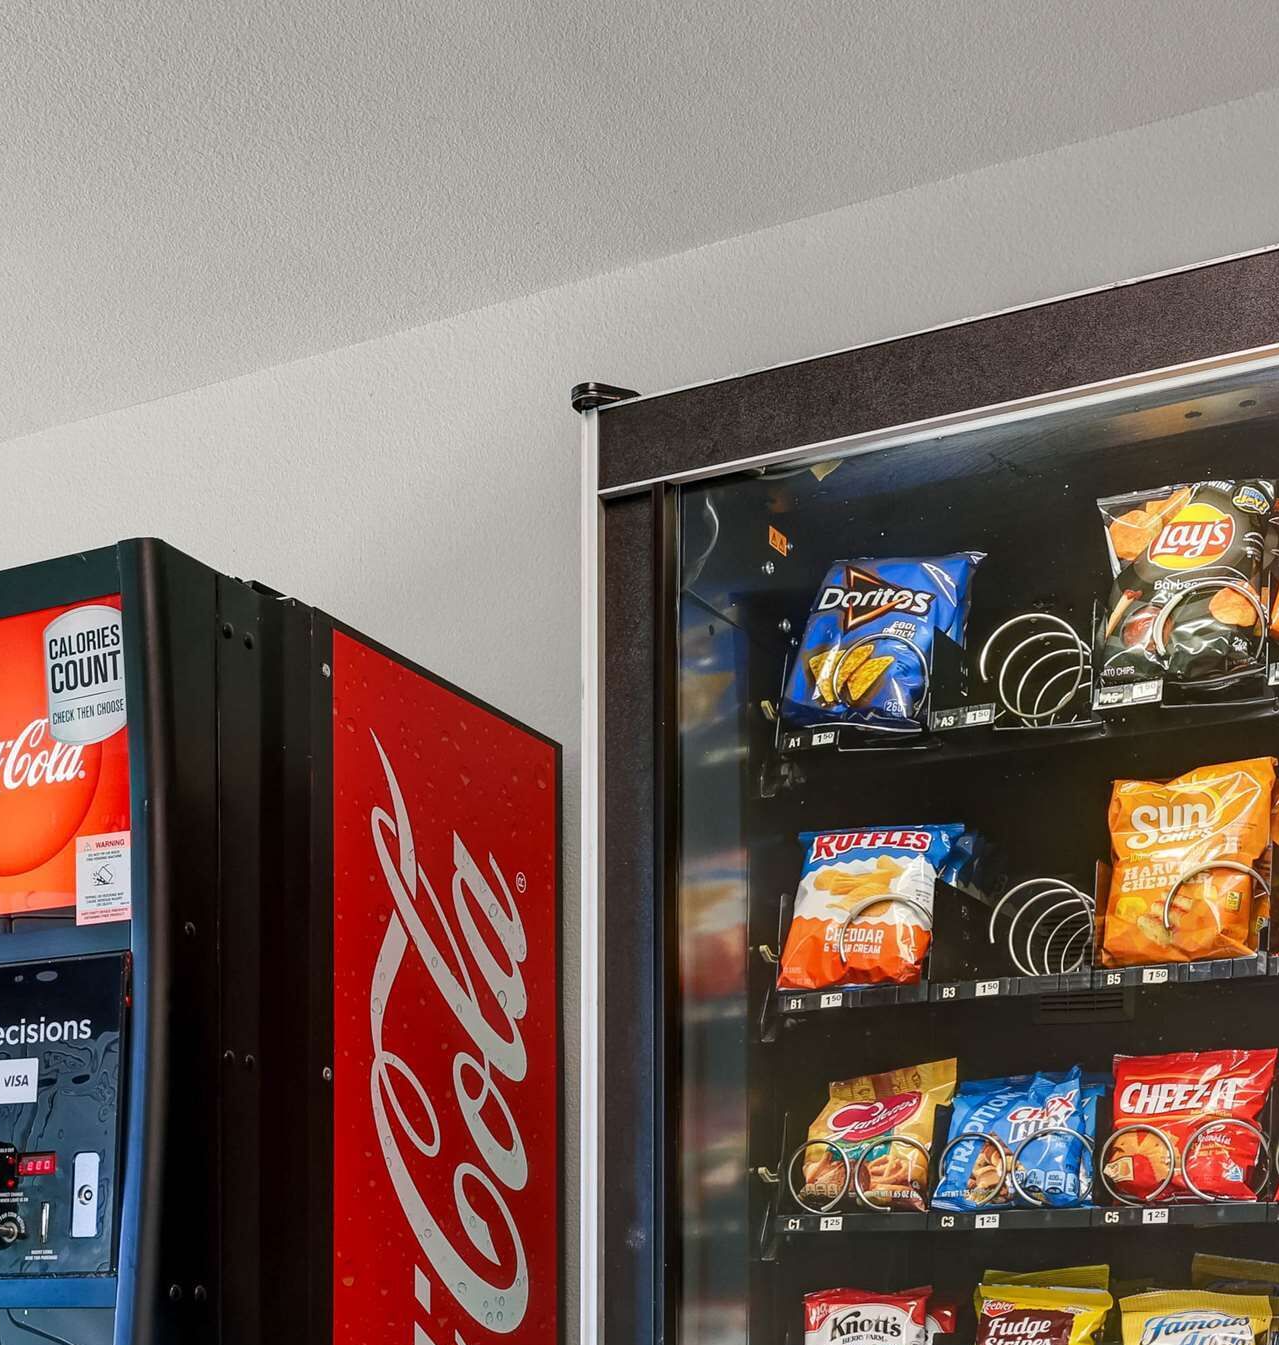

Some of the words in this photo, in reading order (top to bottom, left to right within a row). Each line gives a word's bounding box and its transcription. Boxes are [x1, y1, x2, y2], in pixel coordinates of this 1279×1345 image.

[1156, 520, 1227, 558] Lay's
[819, 587, 933, 614] Doritos
[891, 620, 916, 631] COOL
[49, 624, 120, 660] CALORIES
[51, 650, 121, 694] COUNT
[53, 706, 75, 725] CHECK
[77, 703, 95, 720] THEN
[97, 699, 124, 717] CHOOSE
[941, 715, 954, 726] A3
[789, 737, 801, 749] A1
[96, 839, 125, 848] WARNING
[810, 831, 932, 862] RUFFLES
[853, 943, 881, 954] CREAM
[1107, 974, 1121, 985] B5
[943, 987, 955, 998] B3
[790, 999, 802, 1009] B1
[4, 1075, 29, 1087] VISA
[1105, 1211, 1119, 1223] C5
[830, 1312, 901, 1342] Knott's
[988, 1317, 1052, 1338] Fudge
[842, 1335, 864, 1345] BERRY
